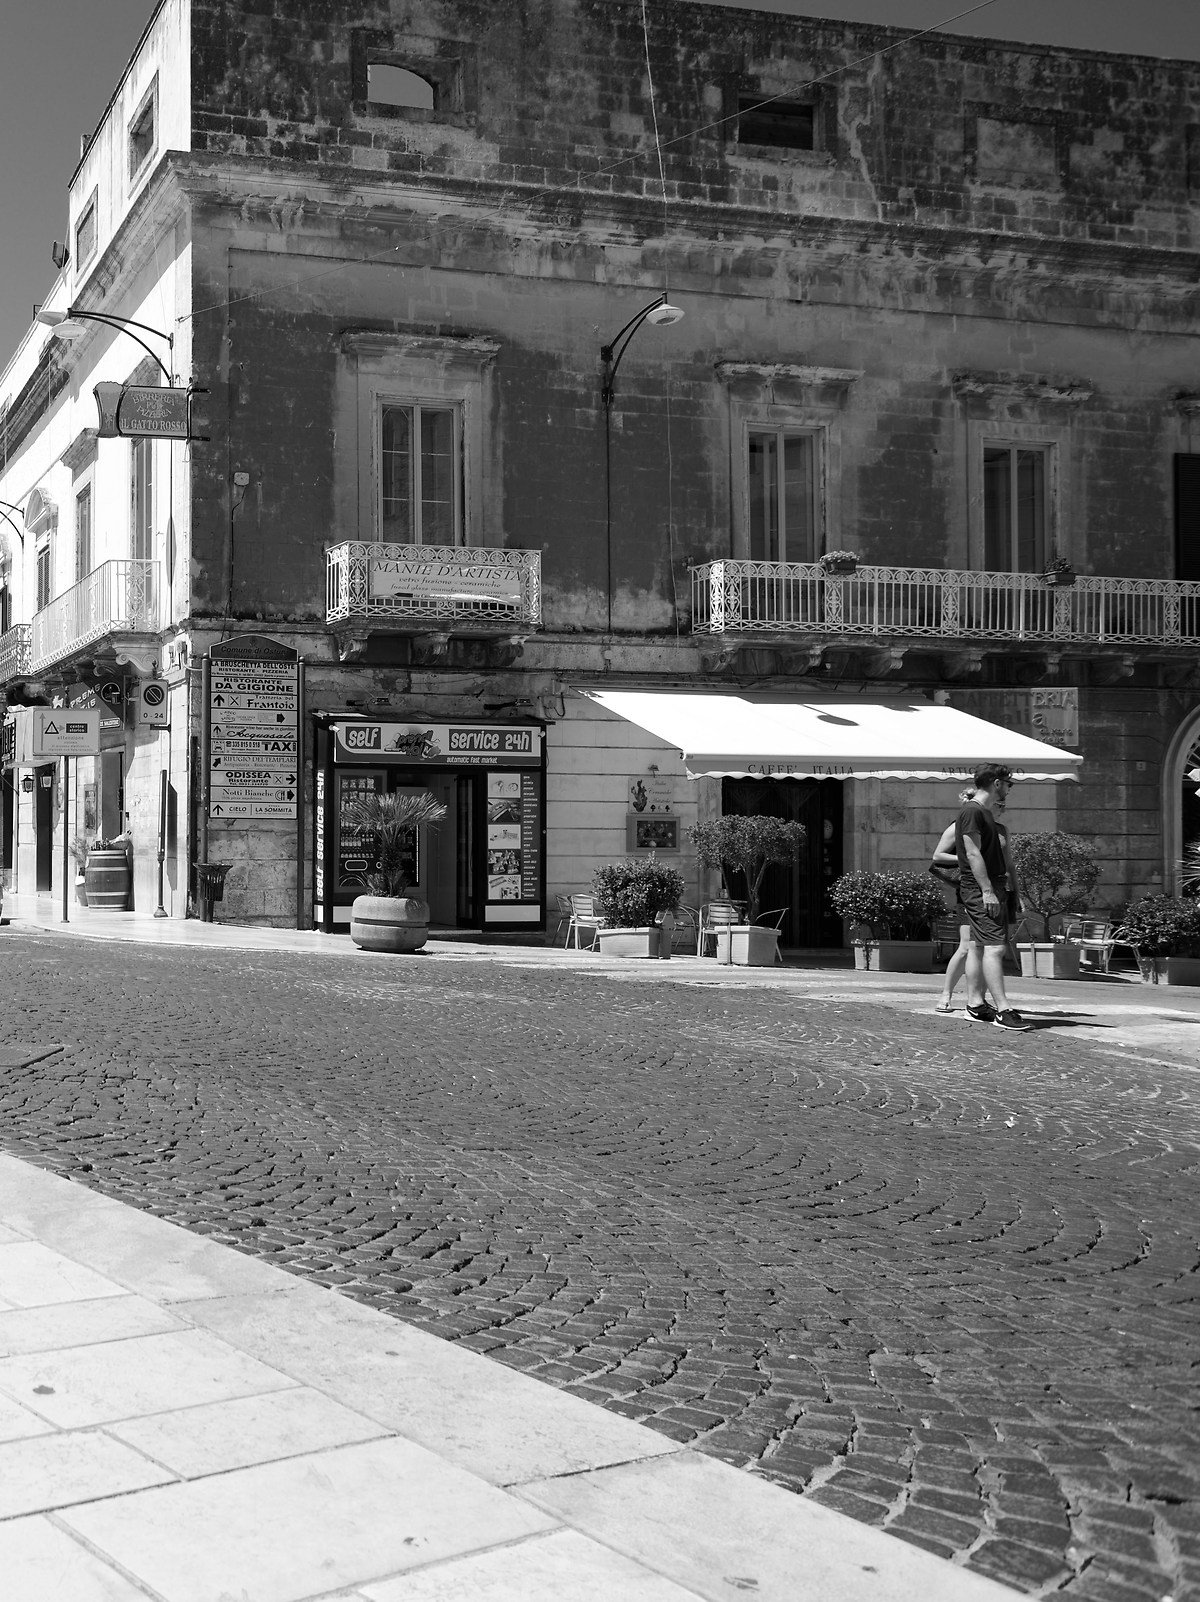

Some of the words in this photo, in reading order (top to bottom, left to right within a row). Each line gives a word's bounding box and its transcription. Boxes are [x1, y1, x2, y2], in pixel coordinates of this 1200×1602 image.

[133, 393, 175, 406] BIRRERIA
[121, 418, 130, 429] IL
[131, 419, 158, 430] GATTO
[160, 420, 187, 432] ROSSO
[373, 561, 433, 576] MANIE
[437, 564, 521, 581] D'ARTISTA
[421, 576, 452, 585] fusione
[221, 646, 253, 654] Comune
[263, 647, 287, 655] Ostuni
[220, 661, 262, 669] BRUSCHETTA
[215, 682, 233, 690] DA
[237, 683, 294, 692] GIGIONE
[247, 698, 295, 709] Frantoio
[348, 727, 379, 748] self
[450, 730, 500, 750] service
[505, 731, 530, 750] 24h
[470, 756, 480, 764] fast
[226, 771, 272, 779] ODISSEA
[747, 764, 798, 776] CAFFE'
[812, 765, 854, 775] ITALIA
[315, 772, 325, 800] 24h
[222, 788, 243, 796] Notti
[244, 789, 274, 797] Bianche
[315, 805, 324, 861] service
[316, 864, 324, 898] self
